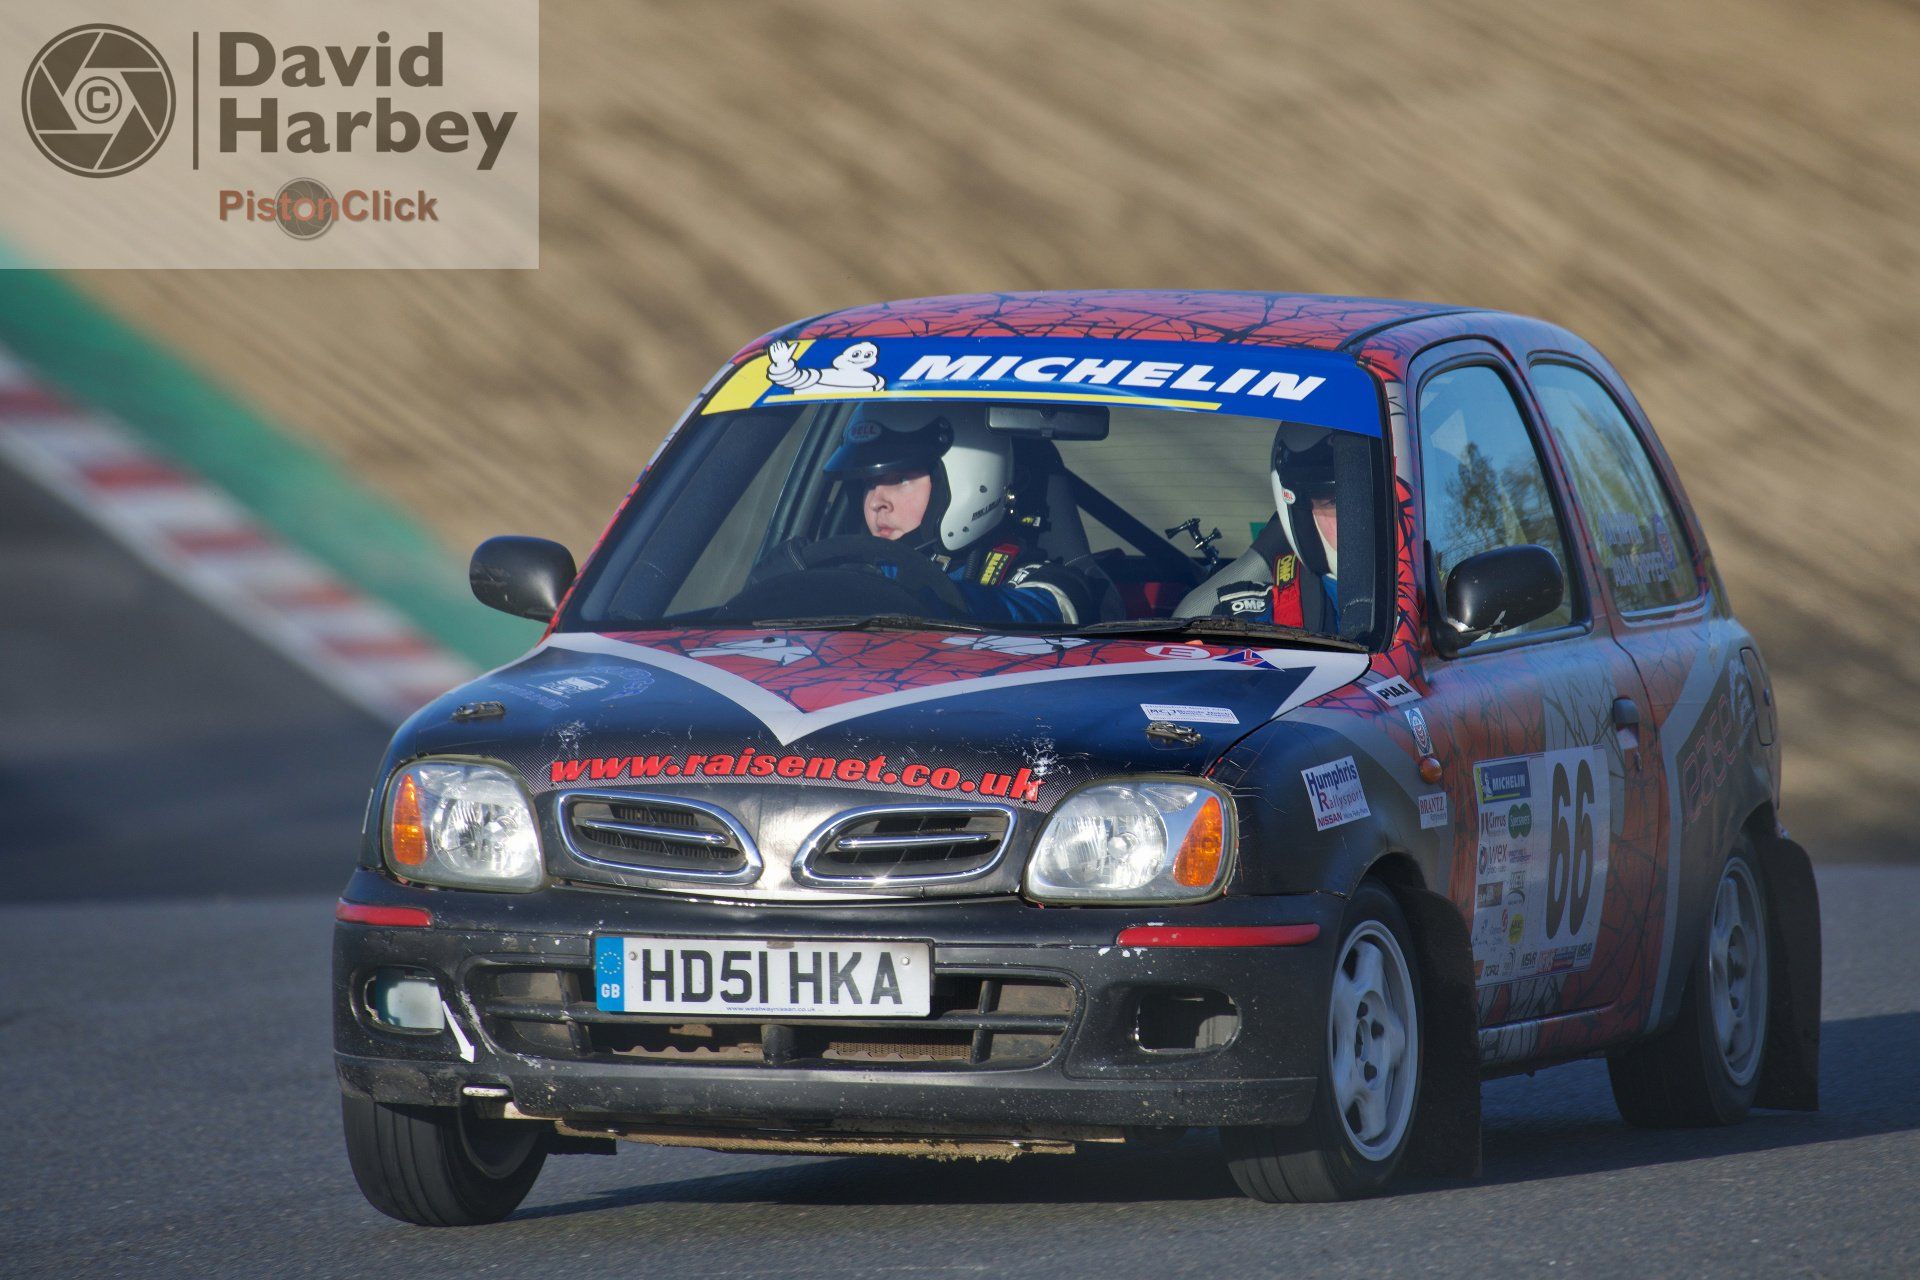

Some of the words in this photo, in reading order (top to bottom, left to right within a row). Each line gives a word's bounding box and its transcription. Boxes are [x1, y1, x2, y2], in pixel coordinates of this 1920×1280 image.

[899, 355, 1326, 402] MICHELIN
[1281, 555, 1291, 583] OMP
[1231, 599, 1266, 612] OMP
[1376, 682, 1413, 699] PIAA
[550, 747, 1046, 802] www.raisenet.co.uk
[1305, 761, 1357, 796] Humphris
[1492, 774, 1526, 791] MICHELIN
[1318, 812, 1343, 827] NISSAN
[1546, 759, 1595, 940] 66
[600, 983, 621, 998] GB
[642, 949, 769, 1003] HD51
[789, 951, 903, 1005] HKA
